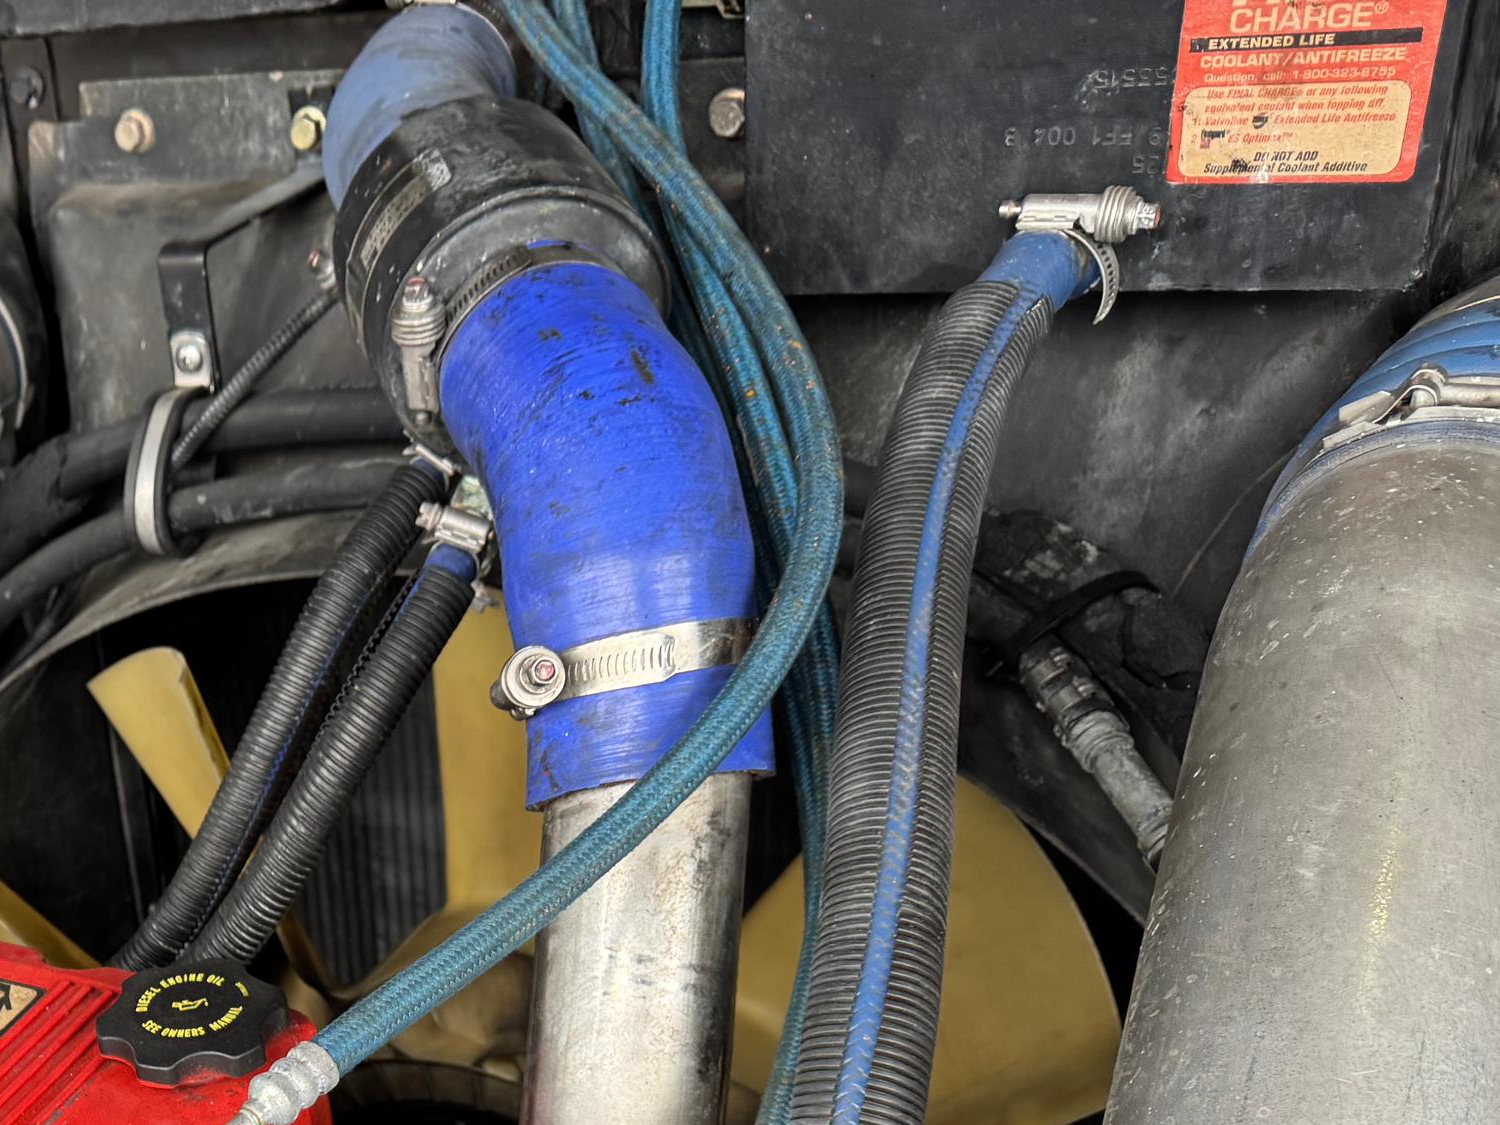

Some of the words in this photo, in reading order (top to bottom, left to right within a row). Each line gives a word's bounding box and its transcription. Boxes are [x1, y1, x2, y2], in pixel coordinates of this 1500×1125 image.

[1208, 35, 1295, 50] EXTENDED
[1299, 33, 1336, 46] LIFE
[1200, 47, 1407, 69] COOLANT/ANTIFREEZE
[1207, 89, 1224, 99] Use
[1227, 88, 1255, 99] FINAL
[1306, 87, 1317, 96] or
[1320, 86, 1338, 97] any
[1341, 84, 1389, 96] following
[1205, 102, 1256, 114] equivalent
[1298, 101, 1325, 110] when
[1327, 99, 1366, 111] topping
[1274, 112, 1319, 124] Extended
[1321, 113, 1341, 123] Life
[1343, 111, 1397, 122] Antifreeze
[1271, 151, 1293, 161] NOT
[1296, 150, 1319, 160] ADD
[1204, 158, 1275, 175] Supplemenal
[1277, 162, 1320, 173] Coolant
[1321, 160, 1369, 172] Additive
[135, 986, 161, 1012] DIESEL
[159, 972, 205, 989] ENGINE
[206, 974, 225, 987] OIL
[141, 1019, 163, 1034] SEE
[160, 1026, 206, 1038] OWNERS
[208, 1005, 243, 1032] MANUAL
